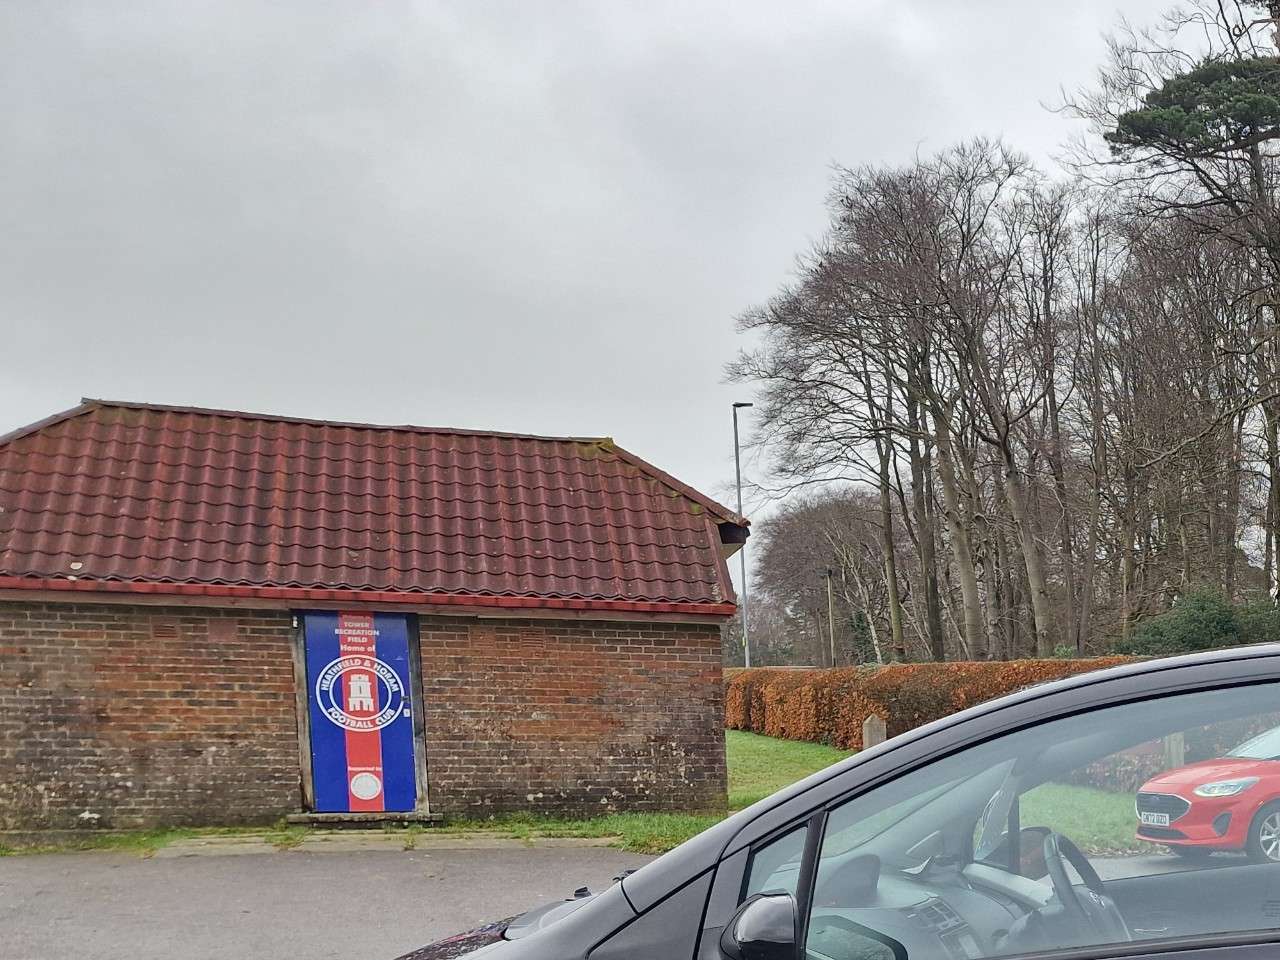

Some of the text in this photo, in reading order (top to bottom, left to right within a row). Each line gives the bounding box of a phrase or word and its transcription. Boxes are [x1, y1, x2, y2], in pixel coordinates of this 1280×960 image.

[335, 628, 379, 636] RECREATION
[320, 658, 400, 692] HEATHFIELD & HORAM
[327, 707, 396, 728] FOOTBALL CLUB
